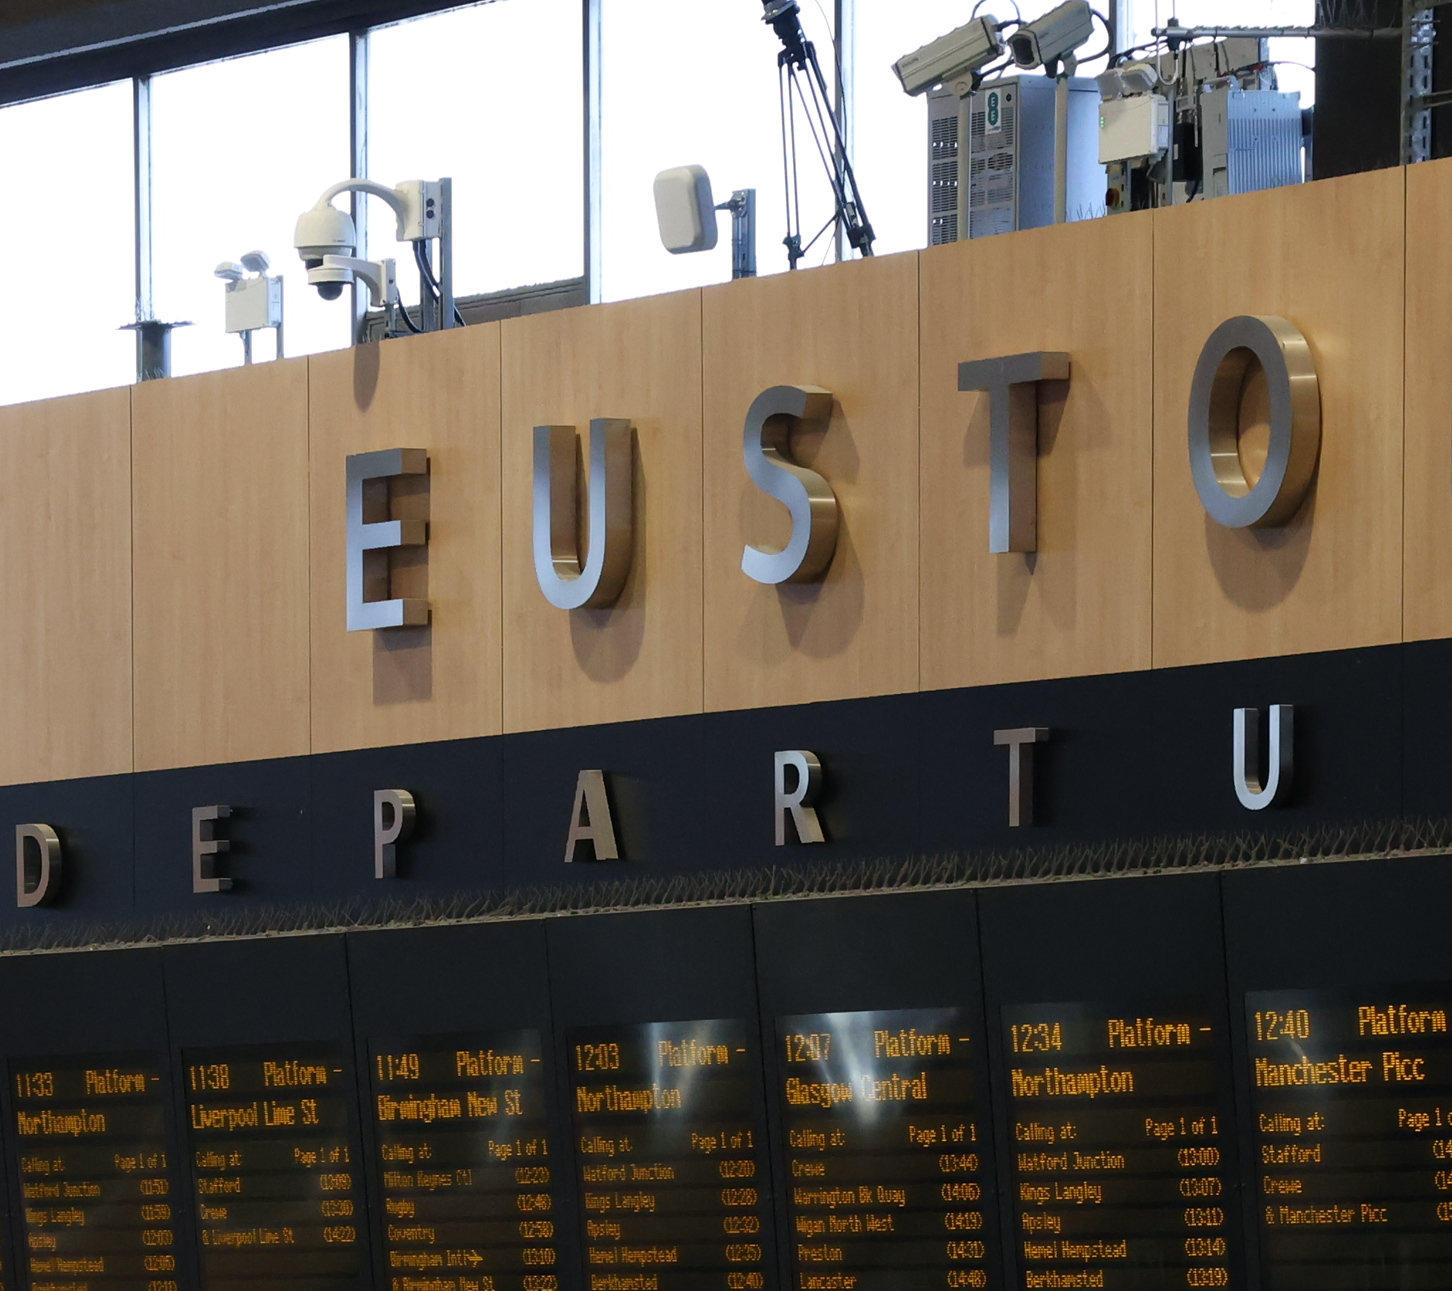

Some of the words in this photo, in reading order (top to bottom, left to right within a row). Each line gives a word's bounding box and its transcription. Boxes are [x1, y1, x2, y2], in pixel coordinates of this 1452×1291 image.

[1011, 1022, 1061, 1053] 12:34
[1108, 1020, 1191, 1049] Platform
[1255, 1010, 1309, 1041] 12:40
[1359, 1005, 1446, 1036] Platform
[190, 1064, 229, 1092] 11:38
[264, 1061, 327, 1088] Platform
[1012, 1064, 1134, 1100] Northampton
[1256, 1055, 1372, 1087] Manchester
[1384, 1051, 1425, 1081] Picc
[191, 1102, 257, 1132] Liverpool
[264, 1100, 294, 1128] Lime
[301, 1098, 319, 1125] St
